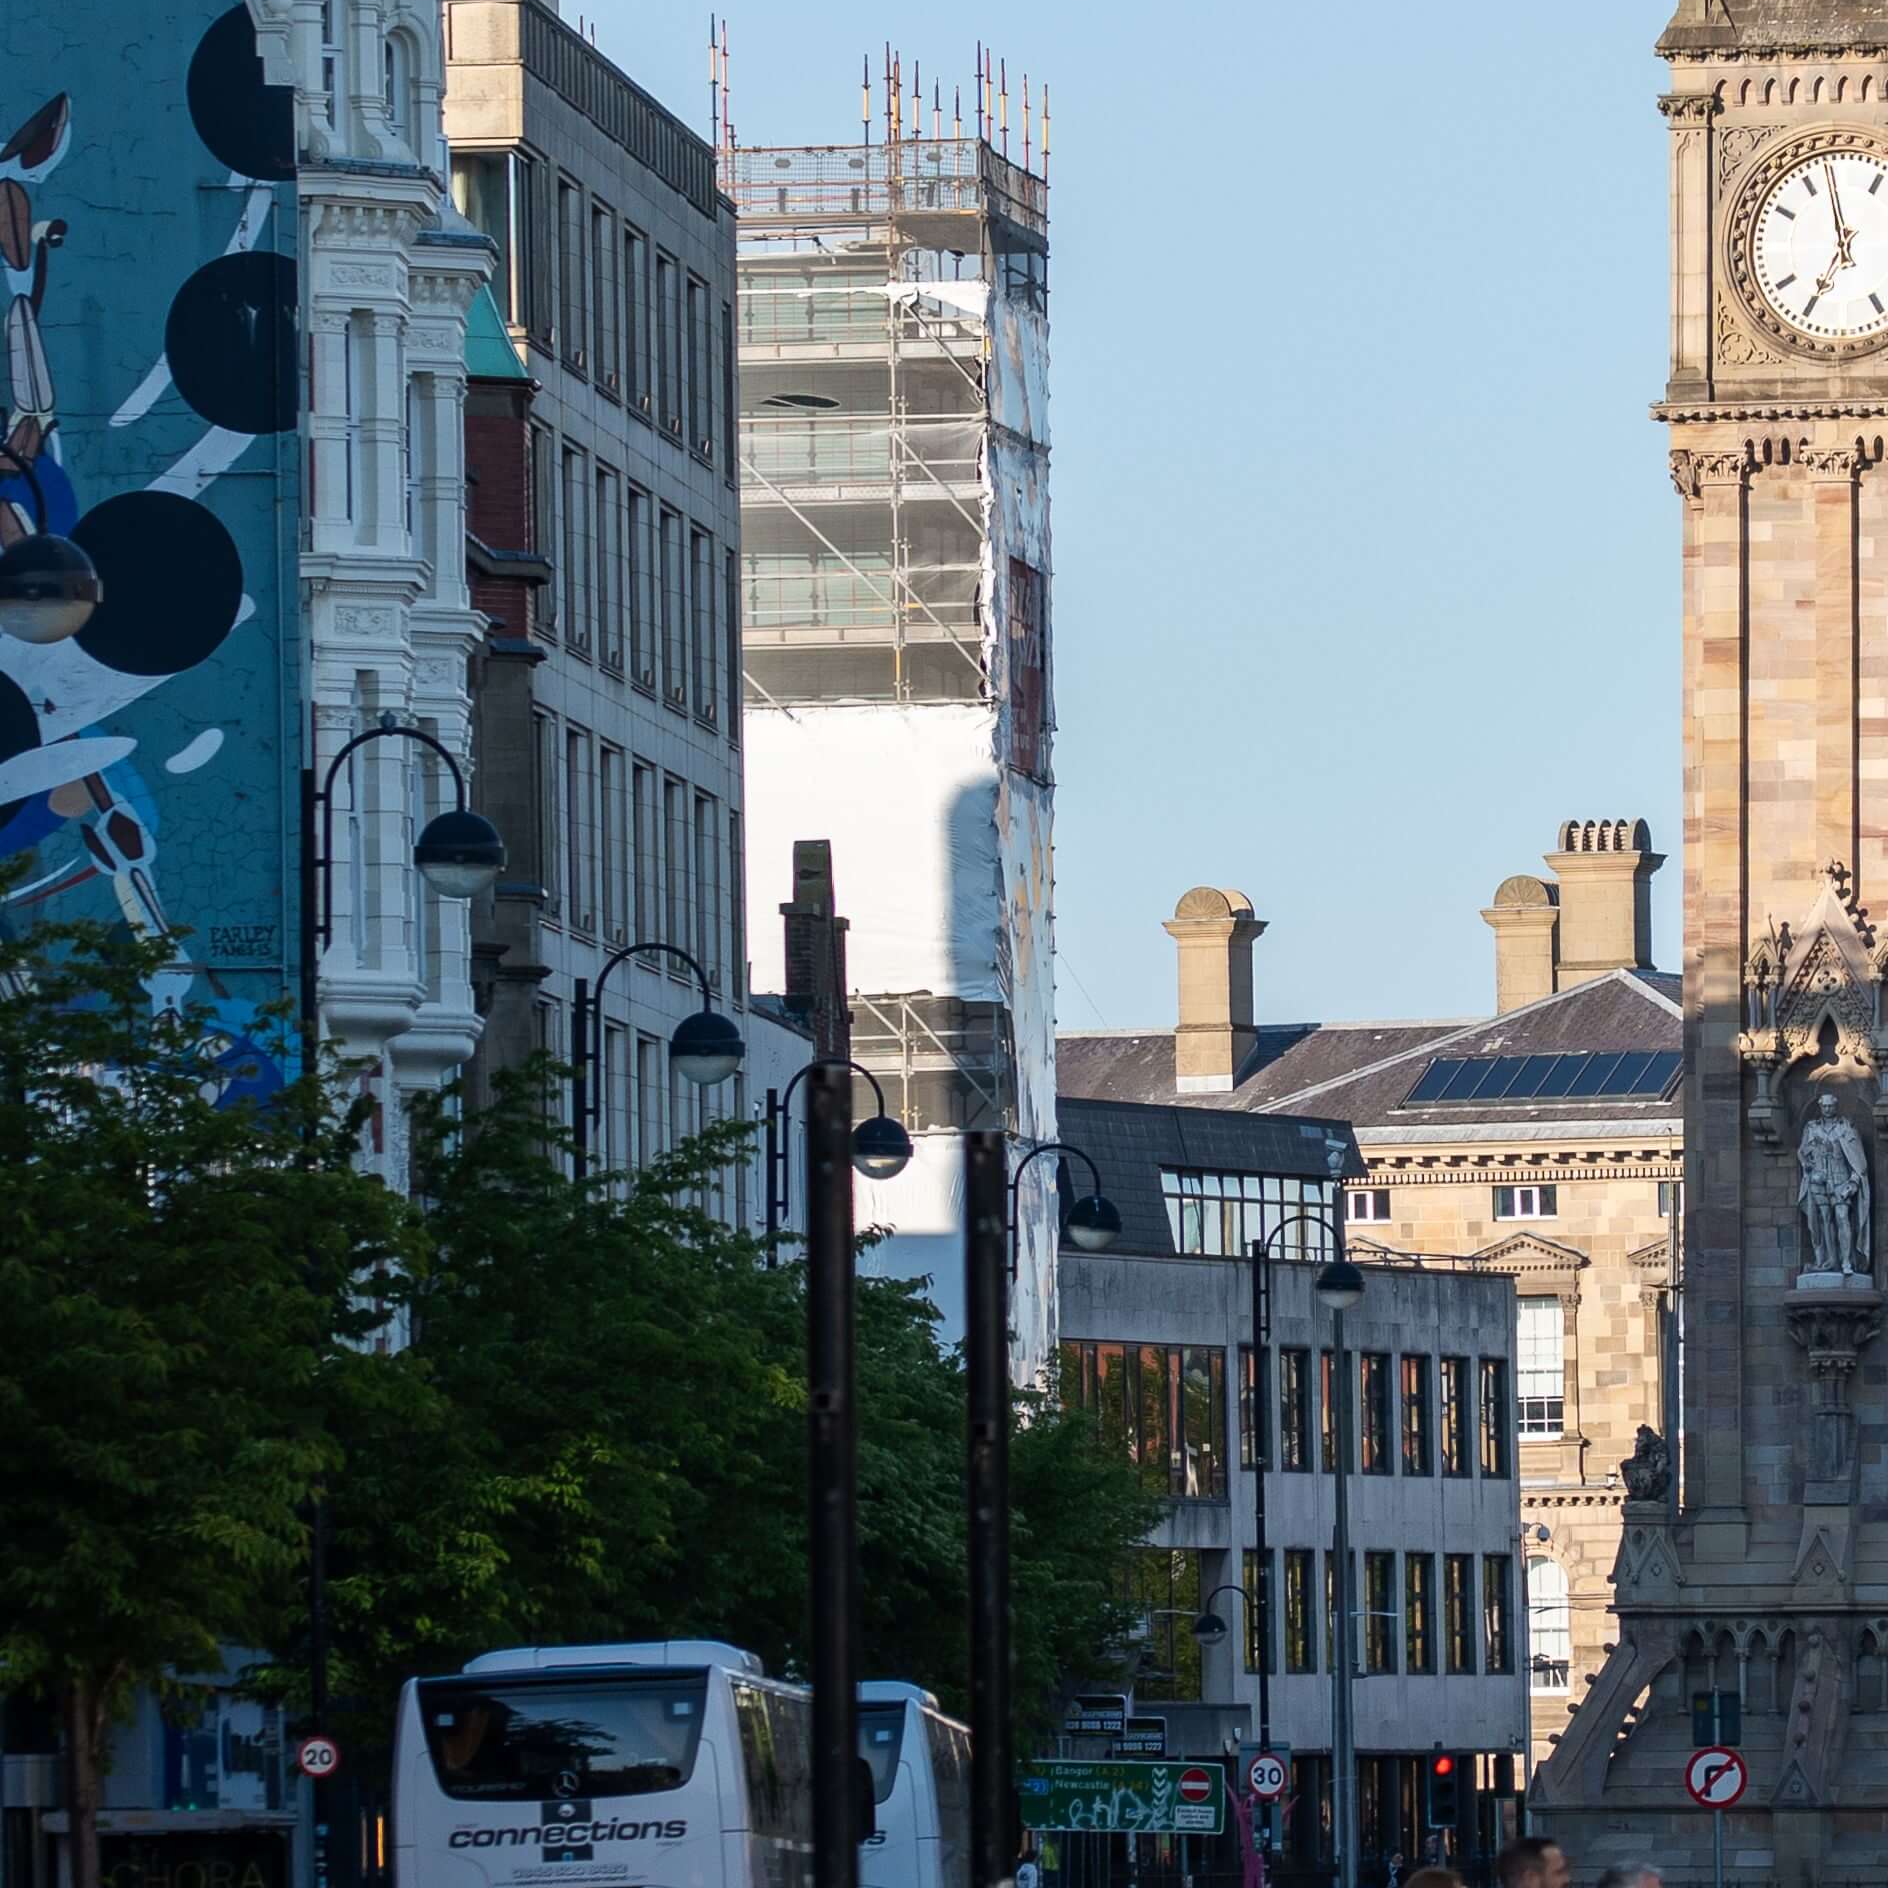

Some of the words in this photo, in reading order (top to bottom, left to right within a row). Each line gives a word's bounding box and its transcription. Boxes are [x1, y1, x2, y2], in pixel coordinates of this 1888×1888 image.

[305, 1749, 332, 1766] 20
[1055, 1765, 1093, 1777] Bangor
[1253, 1767, 1282, 1785] 30
[1054, 1778, 1110, 1791] Newcastle
[449, 1816, 688, 1850] connections
